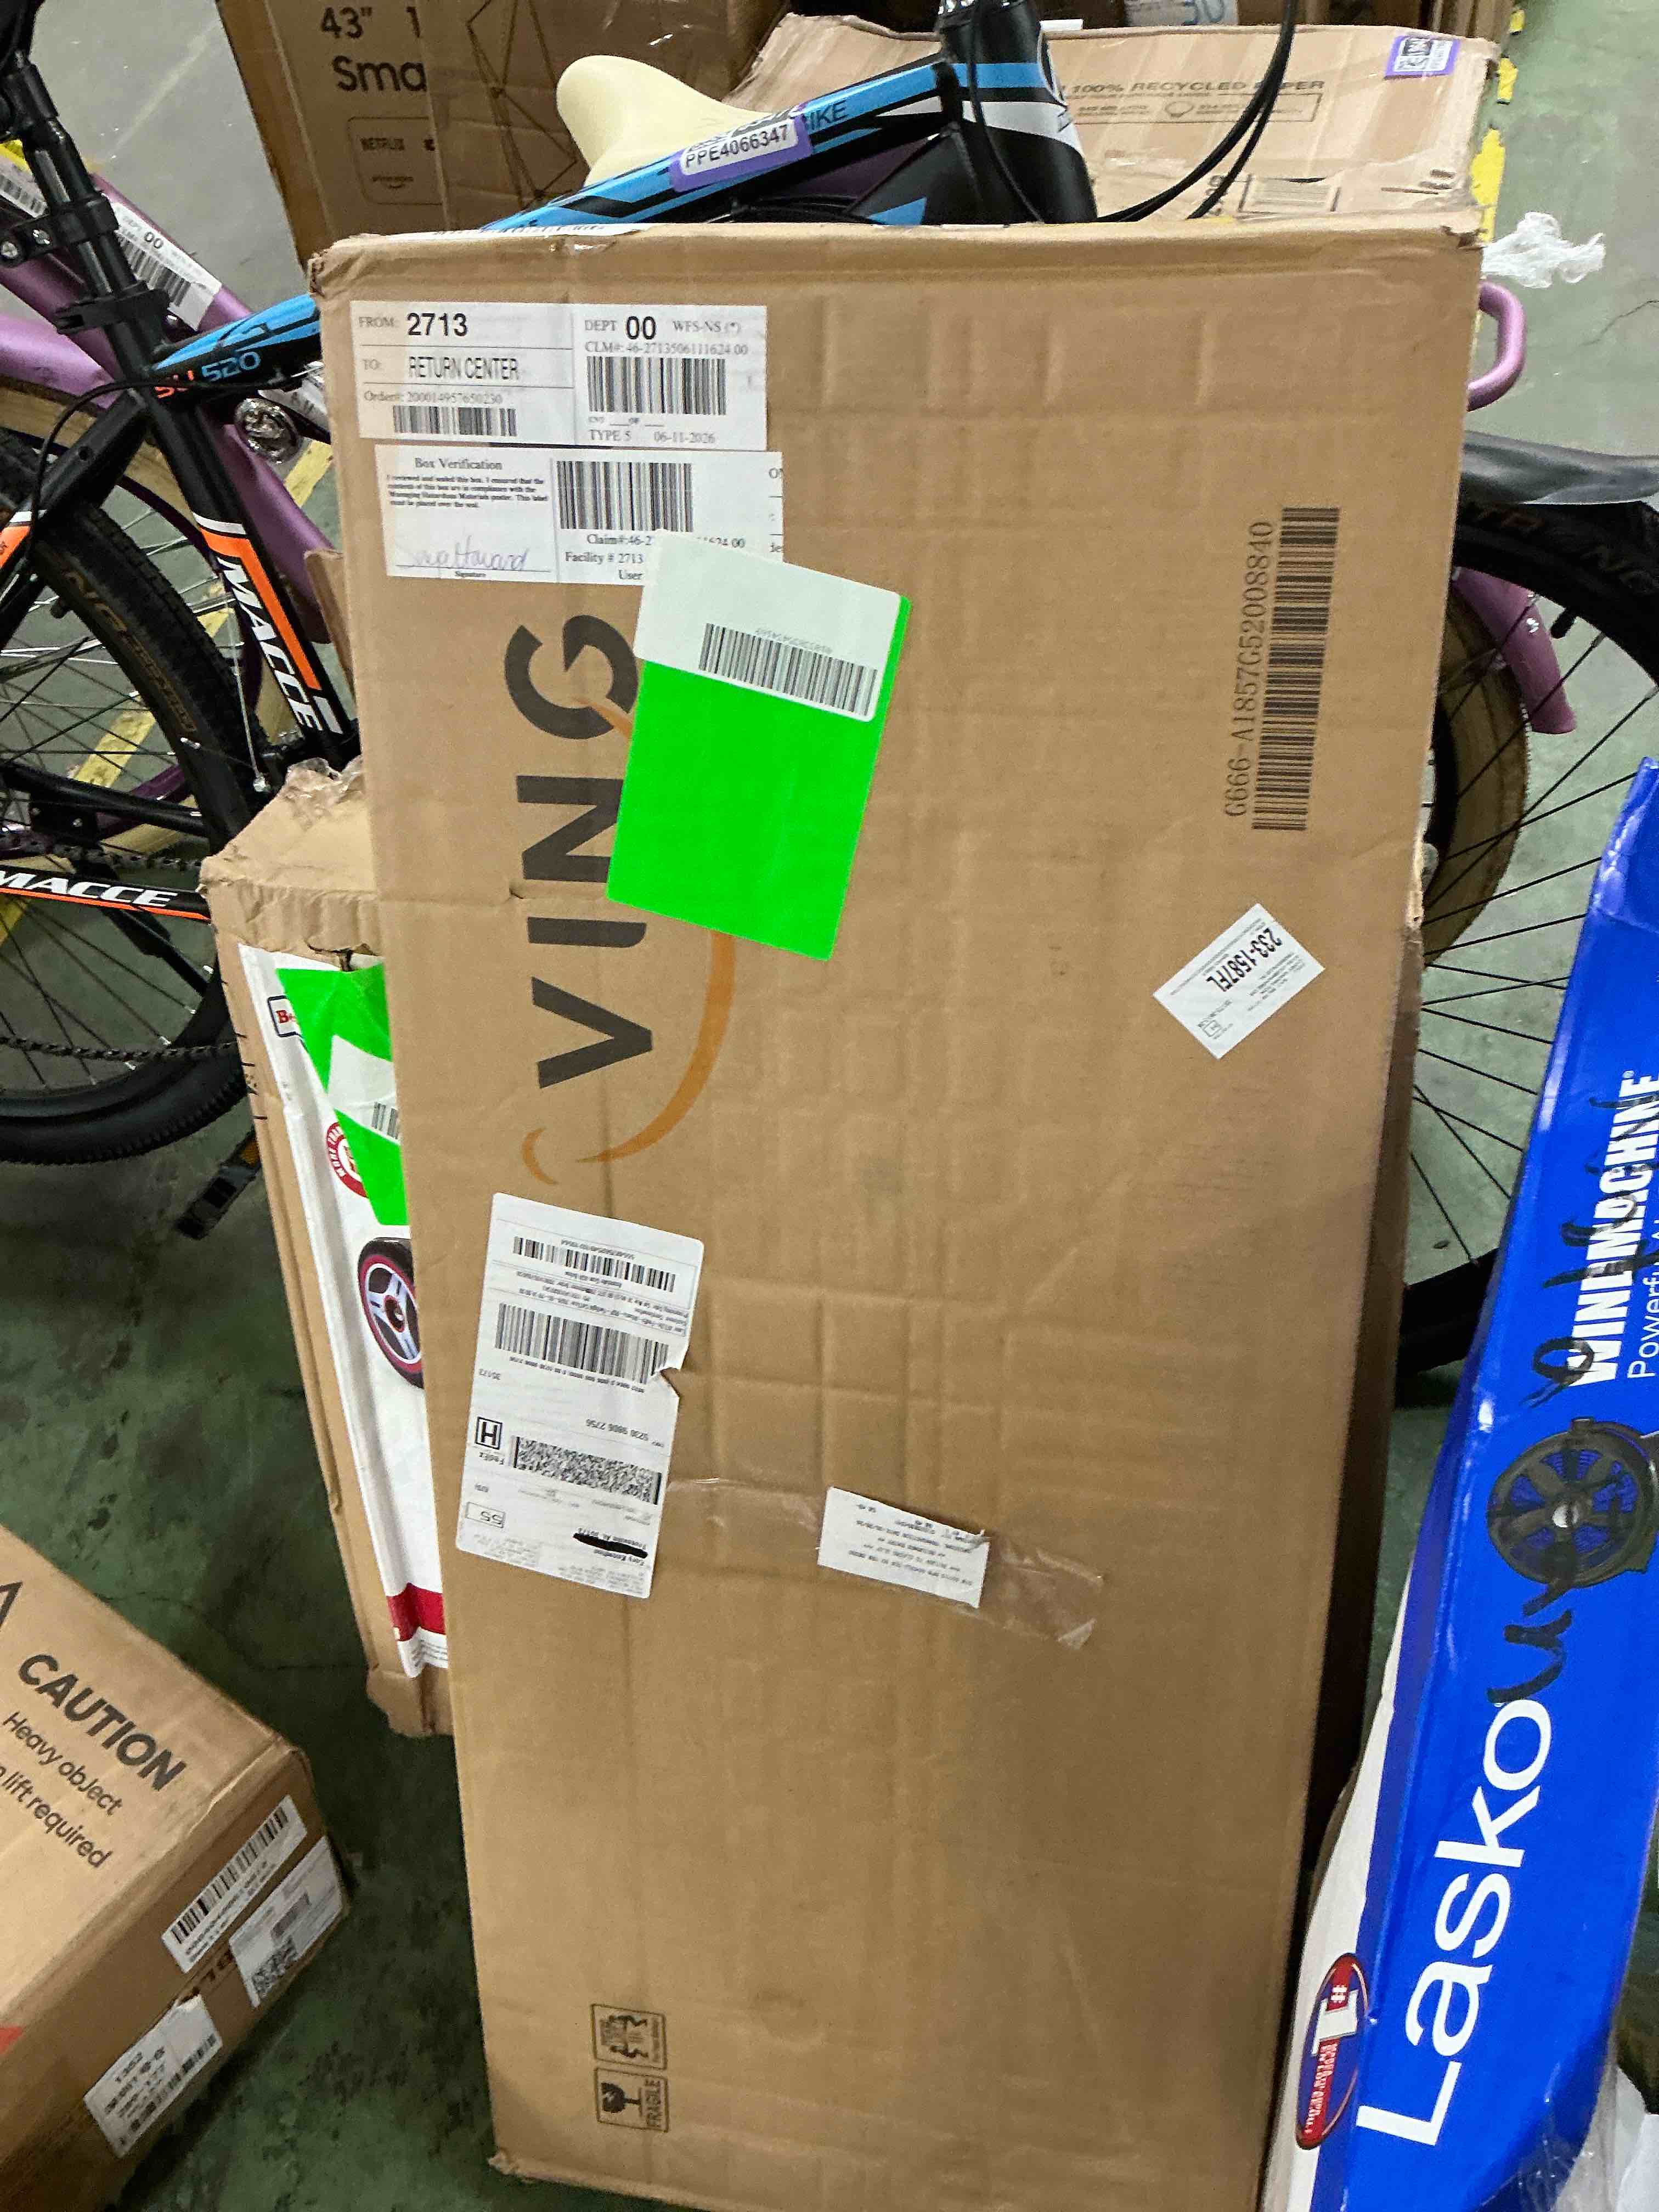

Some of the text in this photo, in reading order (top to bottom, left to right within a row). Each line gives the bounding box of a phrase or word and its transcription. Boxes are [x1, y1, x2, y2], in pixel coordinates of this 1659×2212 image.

[320, 7, 373, 39] 43"
[1071, 80, 1326, 94] 100% RECYCLED PPER
[685, 125, 789, 168] PPE4066347
[407, 312, 469, 337] 2713
[584, 320, 618, 332] DEPT
[625, 315, 657, 340] 00
[202, 351, 261, 382] 520
[408, 356, 461, 379] RETURN
[464, 357, 521, 381] CENTER
[590, 429, 624, 442] TYPE
[414, 457, 503, 470] Box Verification
[565, 551, 603, 565] Facility
[618, 552, 644, 564] 2713
[618, 569, 644, 580] User
[1205, 927, 1283, 992] 233-1587FL
[479, 1421, 498, 1446] H
[18, 1654, 188, 1792] CAUTION
[2, 1711, 123, 1817] Heavy object
[2, 1770, 114, 1869] lift required
[1355, 1699, 1552, 2146] Lasko
